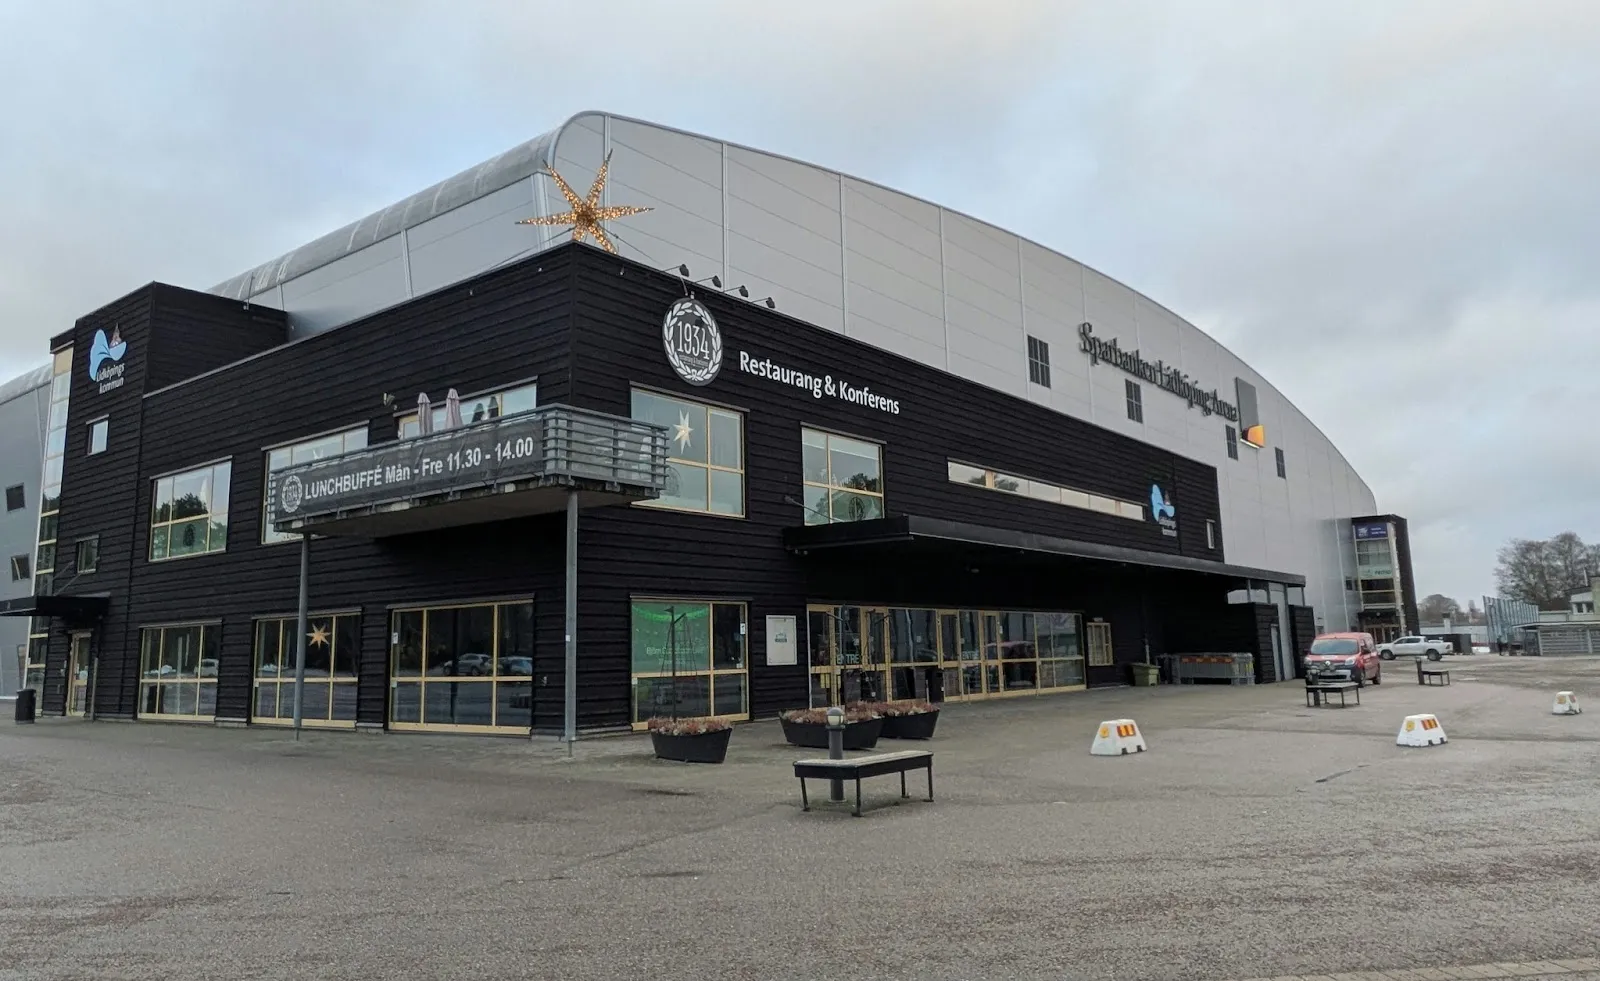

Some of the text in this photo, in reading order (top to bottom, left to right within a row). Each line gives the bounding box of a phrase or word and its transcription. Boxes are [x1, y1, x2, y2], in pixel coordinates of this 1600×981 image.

[677, 321, 709, 359] 1934
[1077, 321, 1157, 385] Sparbanken
[739, 350, 900, 415] Restaurang & Konferens
[305, 465, 382, 500] LUNCHBUFFÉ
[385, 463, 411, 484] Mån
[421, 457, 444, 477] Fre
[446, 447, 482, 471] 11.30
[494, 436, 534, 462] 14.00
